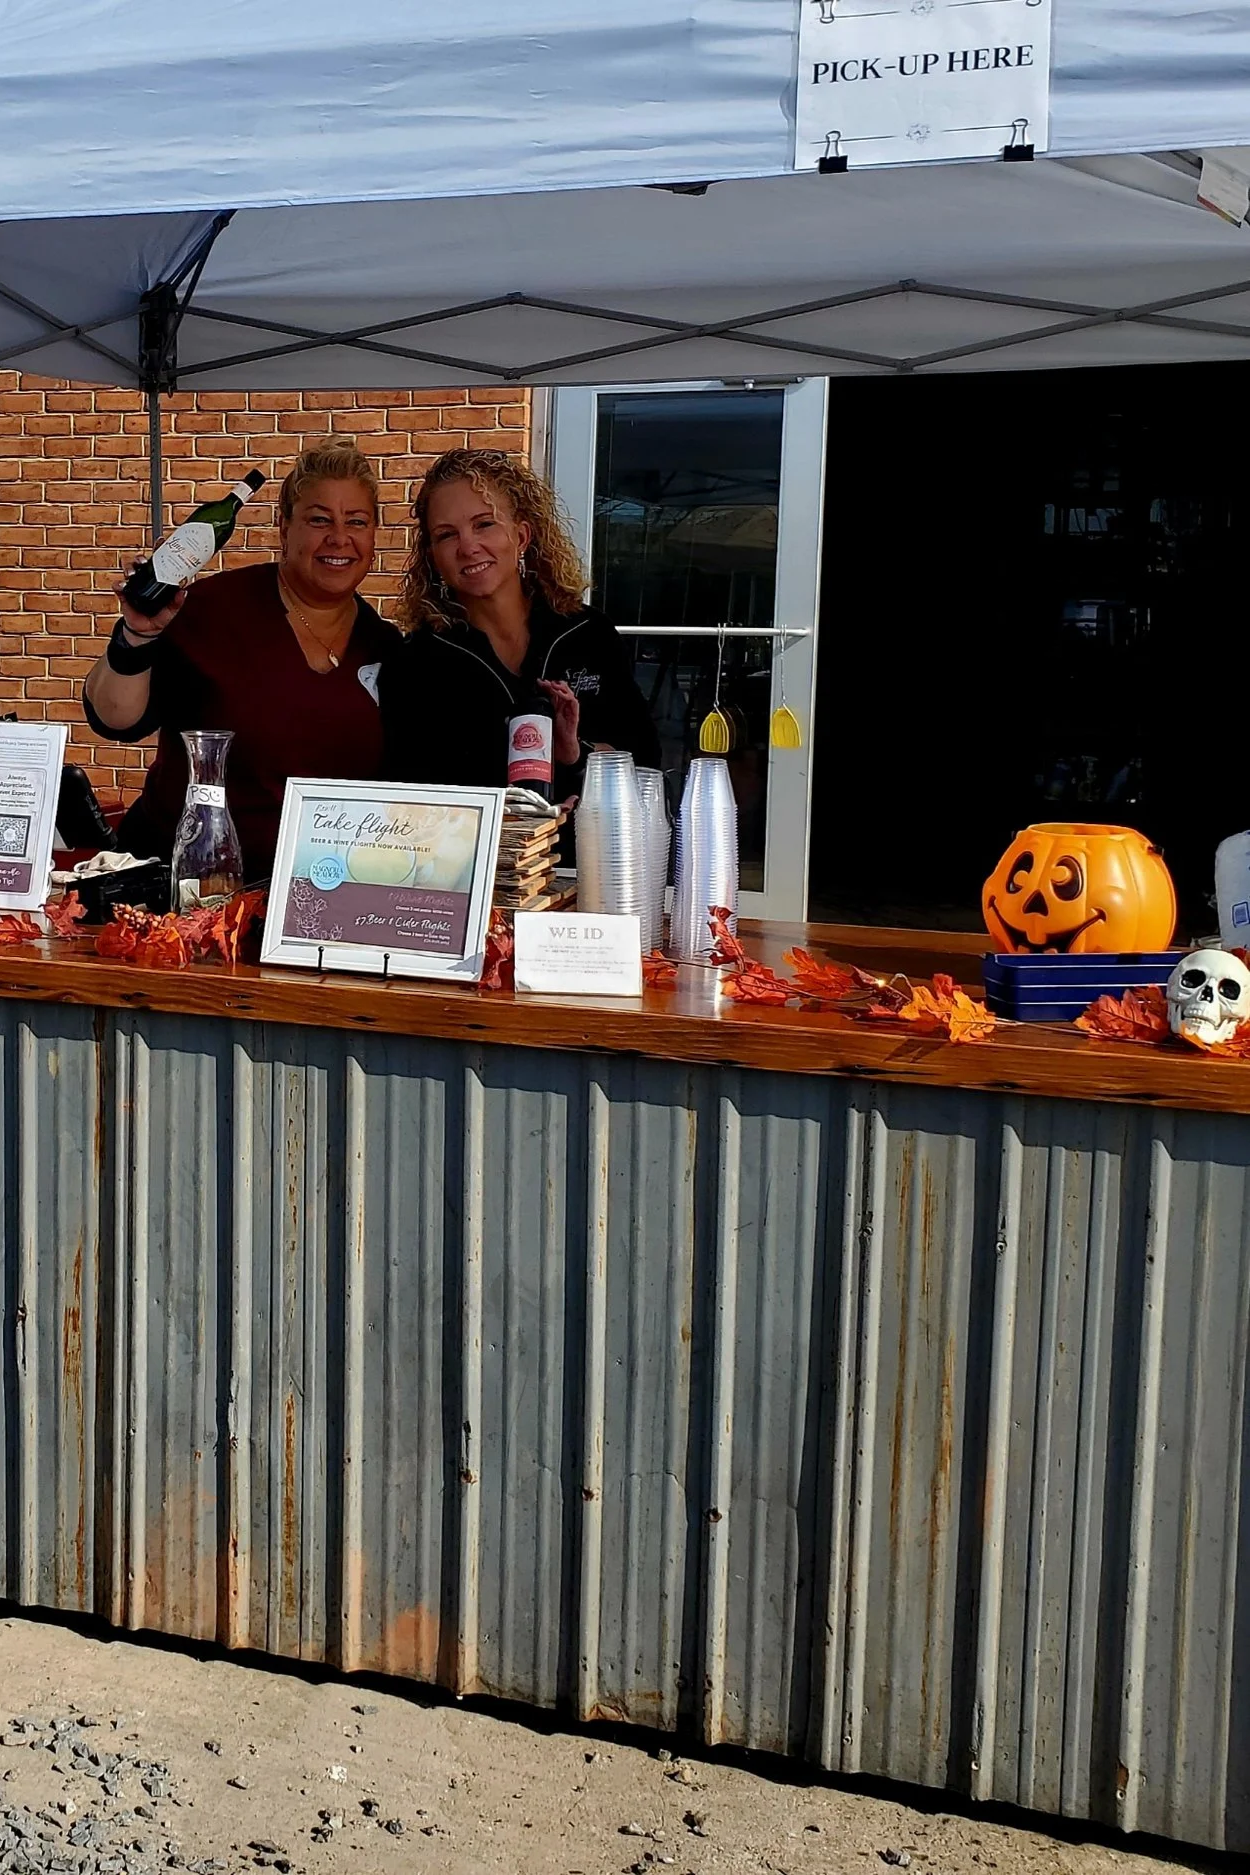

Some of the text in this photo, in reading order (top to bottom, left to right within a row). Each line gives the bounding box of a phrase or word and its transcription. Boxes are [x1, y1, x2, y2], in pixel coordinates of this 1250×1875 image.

[811, 44, 1034, 85] PICK-UP HERE
[313, 812, 414, 842] Take flight
[394, 845, 431, 853] AVAILABLE!
[367, 913, 385, 925] Beer
[395, 916, 420, 929] Cider
[421, 919, 451, 935] Flights
[549, 927, 604, 940] WE ID
